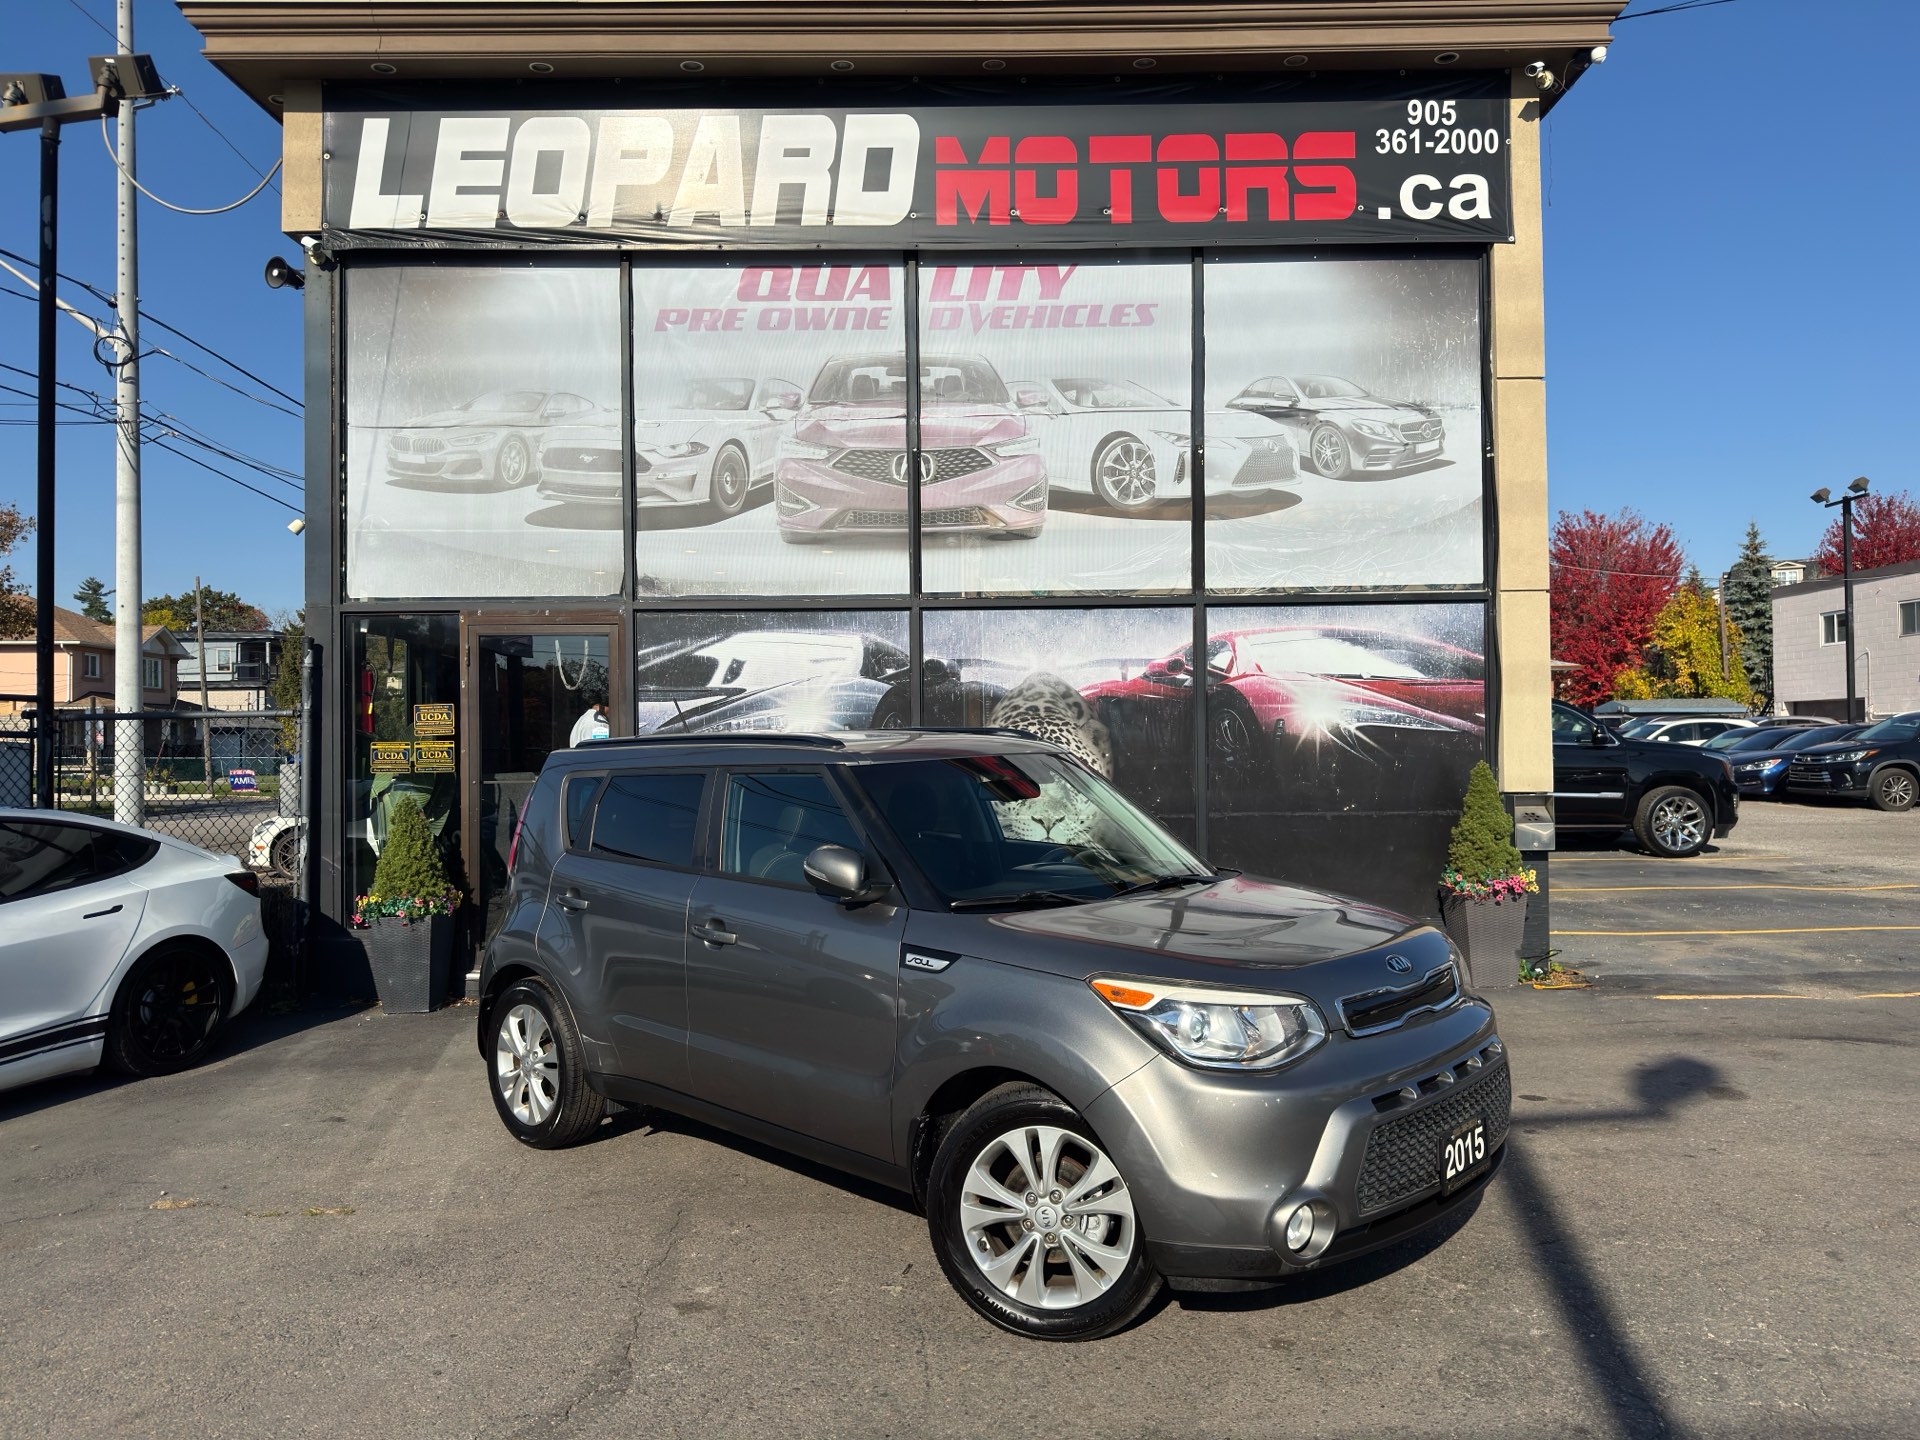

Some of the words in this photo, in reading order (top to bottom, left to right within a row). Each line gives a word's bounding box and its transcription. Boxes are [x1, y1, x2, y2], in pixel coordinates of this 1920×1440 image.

[1407, 99, 1457, 126] 905
[1375, 128, 1499, 154] 361-2000
[350, 114, 920, 229] LEOPARD
[935, 131, 1357, 226] MOTORS
[1377, 173, 1492, 220] .ca
[654, 307, 745, 333] PRE
[420, 712, 449, 721] UCDA
[377, 752, 405, 760] UCDA
[421, 750, 449, 759] UCDA
[907, 957, 934, 968] SOUL
[1388, 956, 1409, 971] KIA
[1445, 1125, 1485, 1180] 2015
